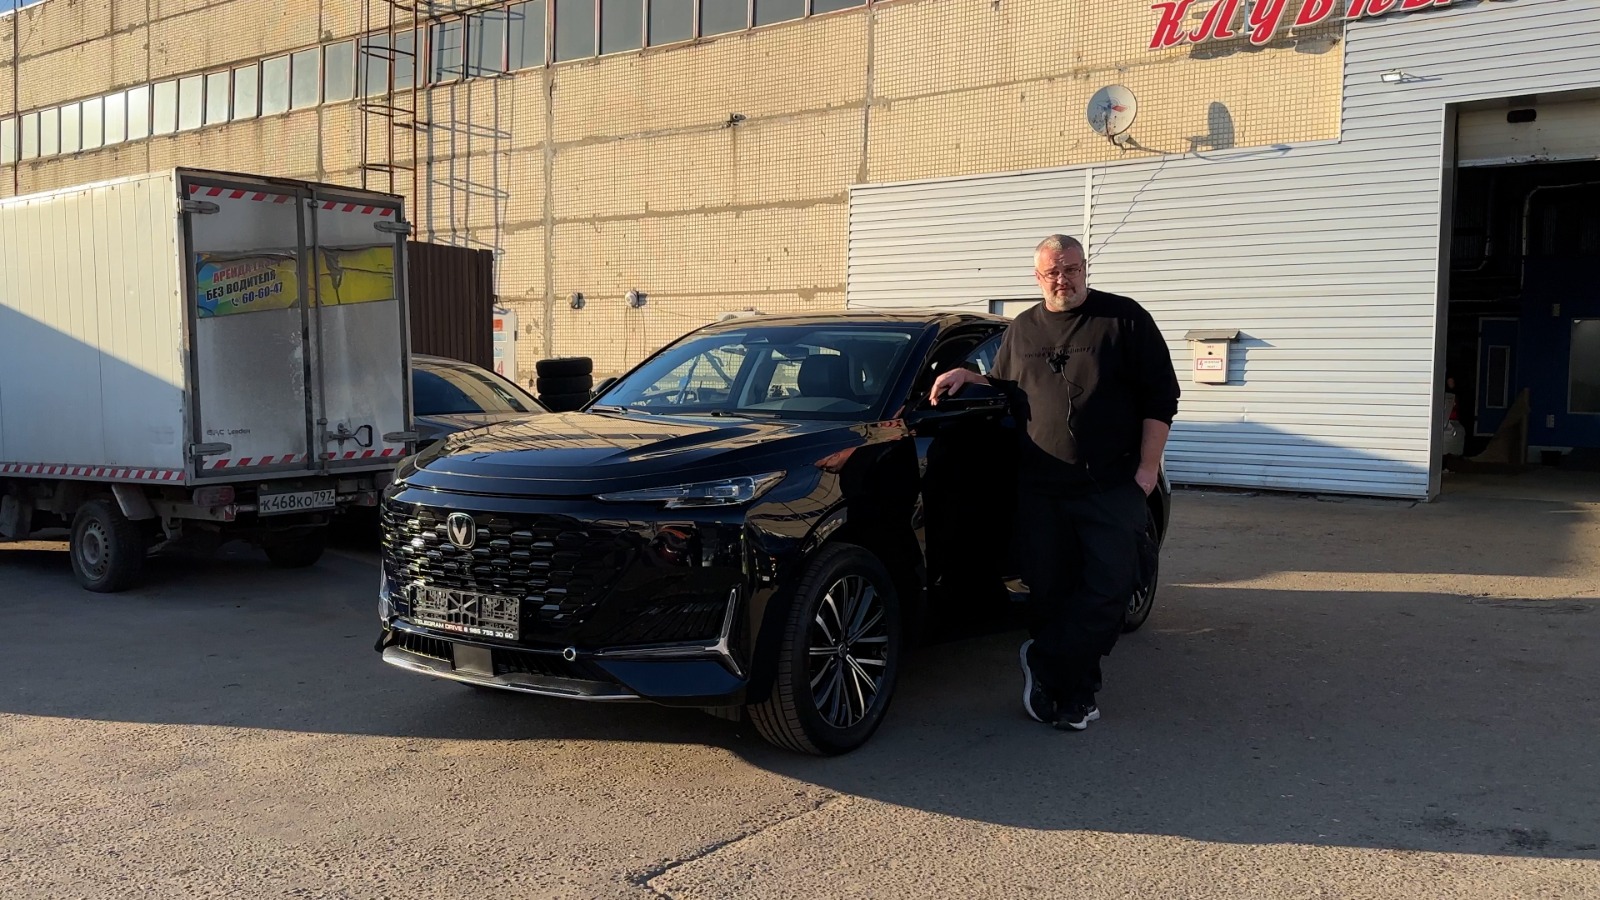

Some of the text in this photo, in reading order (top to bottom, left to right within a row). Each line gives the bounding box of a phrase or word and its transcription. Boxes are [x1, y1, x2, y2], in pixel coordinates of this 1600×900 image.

[207, 270, 276, 300] БЕЗ ВОДИТЕЛЯ
[242, 282, 283, 303] 60-60-47
[414, 618, 445, 628] TELEGRAM
[445, 623, 463, 632] DRIVE
